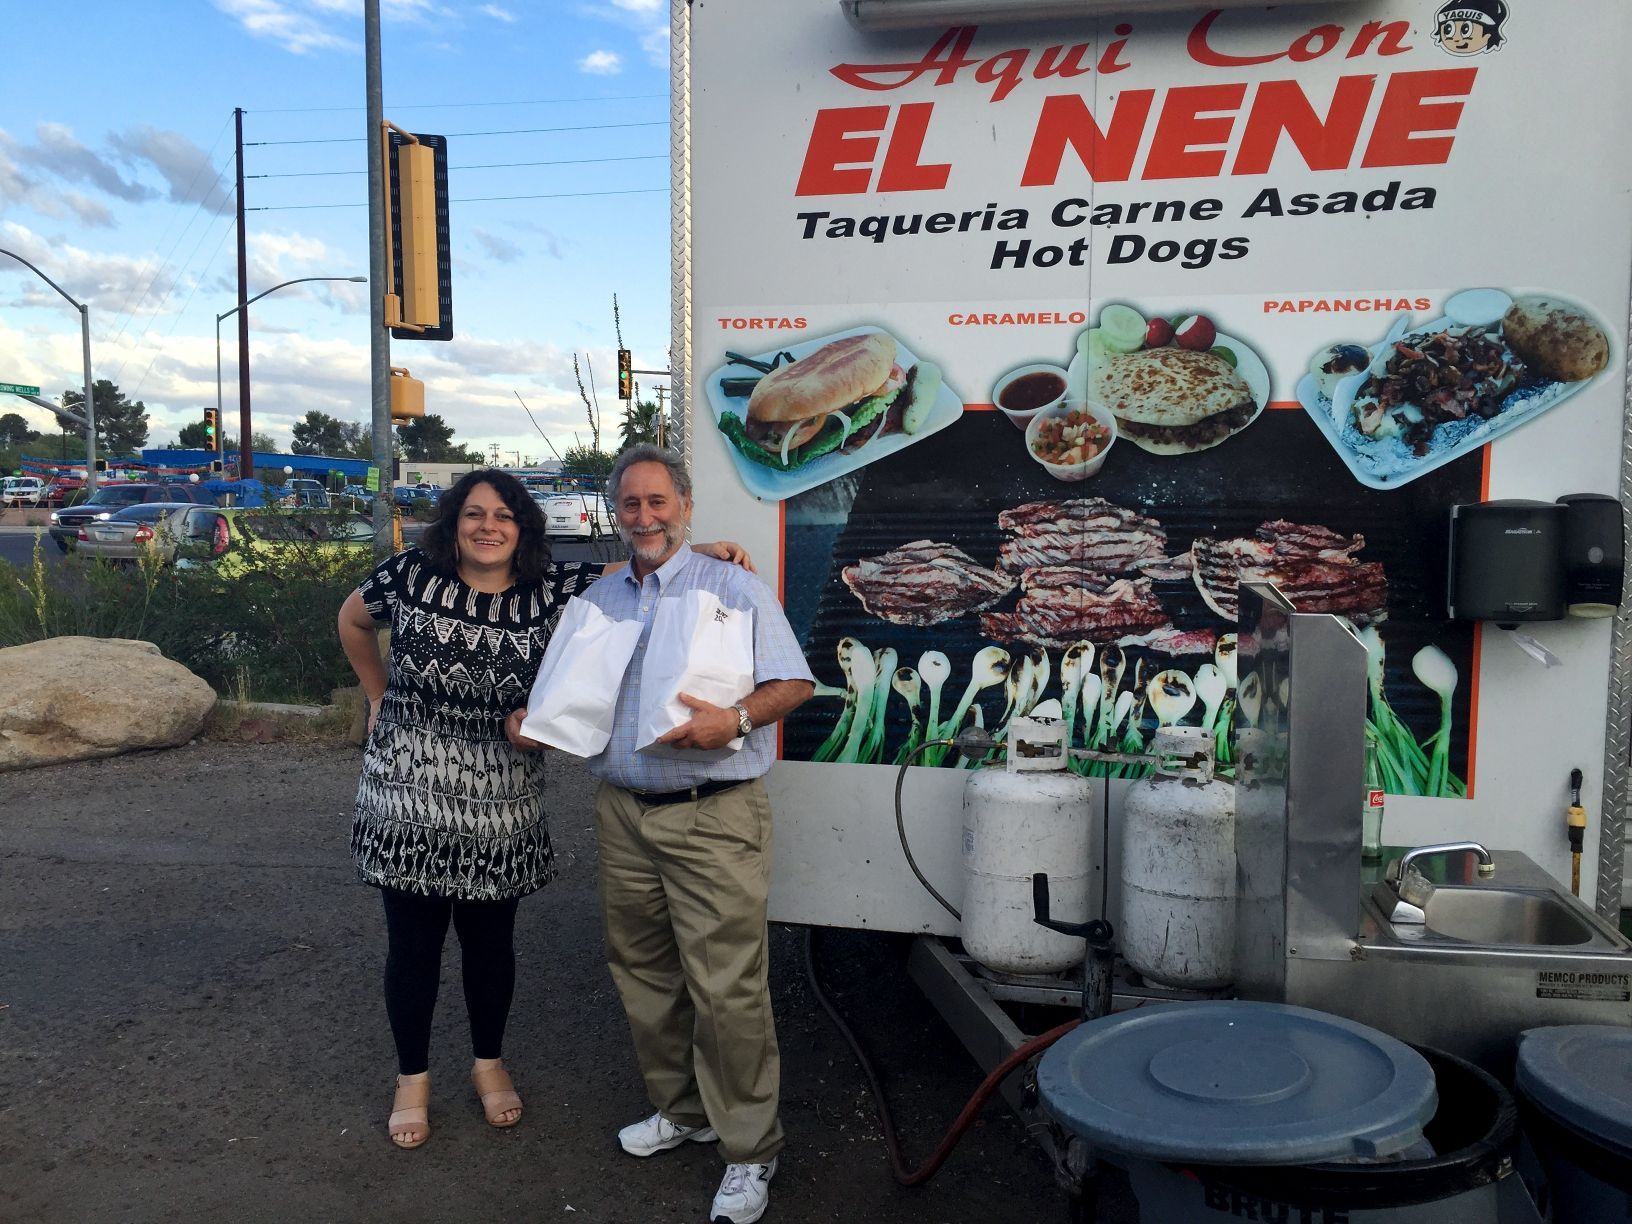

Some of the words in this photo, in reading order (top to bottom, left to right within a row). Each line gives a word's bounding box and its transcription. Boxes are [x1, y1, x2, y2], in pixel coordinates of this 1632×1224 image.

[1443, 10, 1484, 20] YAQUIS
[829, 24, 1133, 103] Aqui
[1187, 9, 1413, 67] Con
[794, 101, 952, 197] EL
[1019, 66, 1478, 188] NENE
[796, 202, 1030, 244] Taqueria
[1051, 197, 1224, 228] Carne
[1240, 180, 1437, 219] Asada
[990, 236, 1089, 270] Hot
[1106, 233, 1250, 270] Dogs
[1263, 297, 1432, 313] PAPANCHAS
[717, 316, 808, 330] TORTAS
[948, 311, 1086, 326] CARAMELO
[16, 385, 30, 394] WELLS
[1539, 971, 1576, 984] MEMCO
[1578, 973, 1629, 985] PRODUCTS
